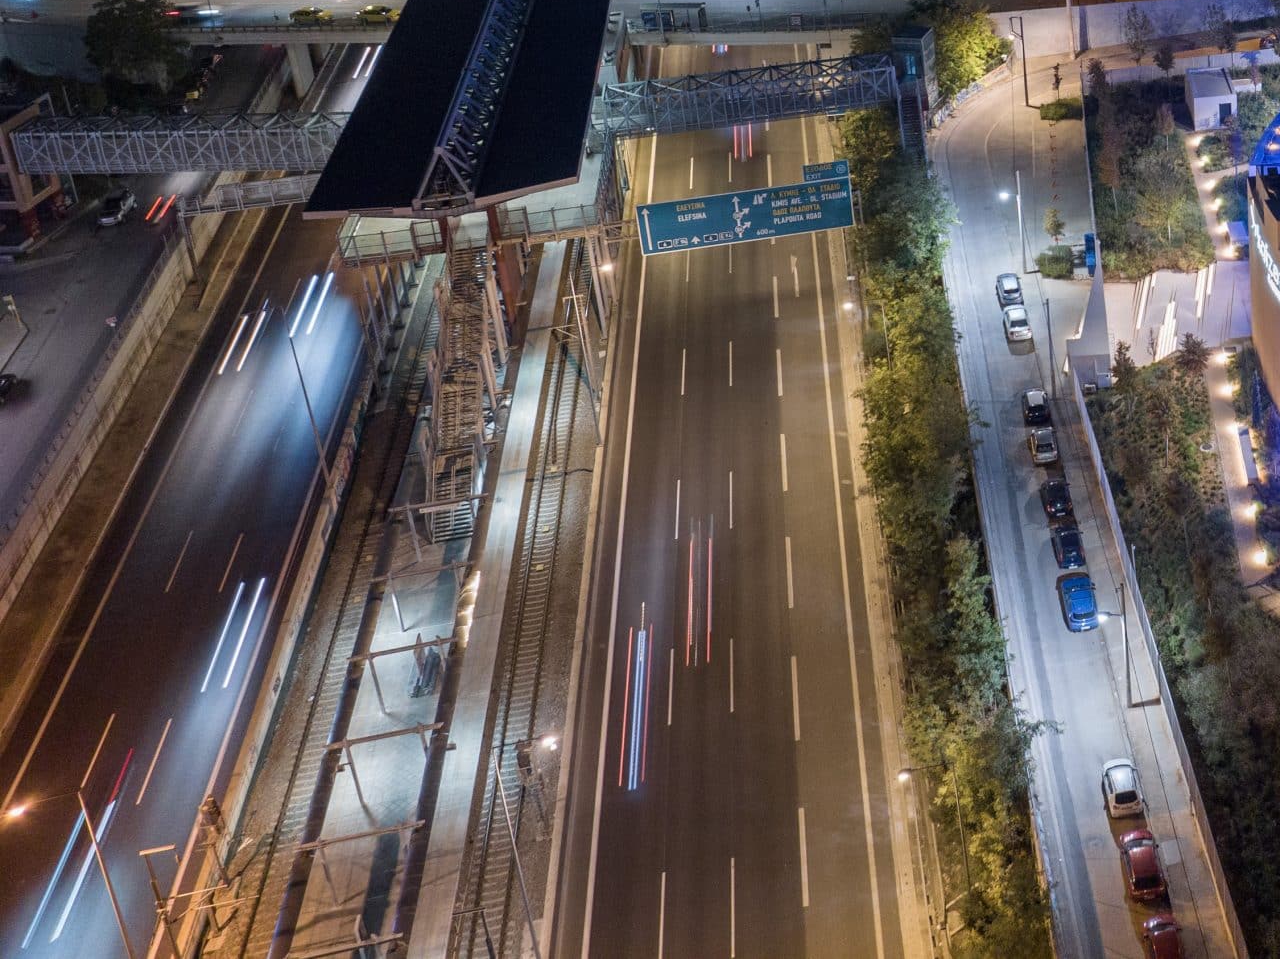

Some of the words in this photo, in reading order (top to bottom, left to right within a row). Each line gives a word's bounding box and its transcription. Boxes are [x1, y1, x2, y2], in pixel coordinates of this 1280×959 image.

[821, 191, 847, 201] STADIUM
[677, 212, 707, 222] ELEFSINA
[774, 215, 803, 225] PLAPOUTA
